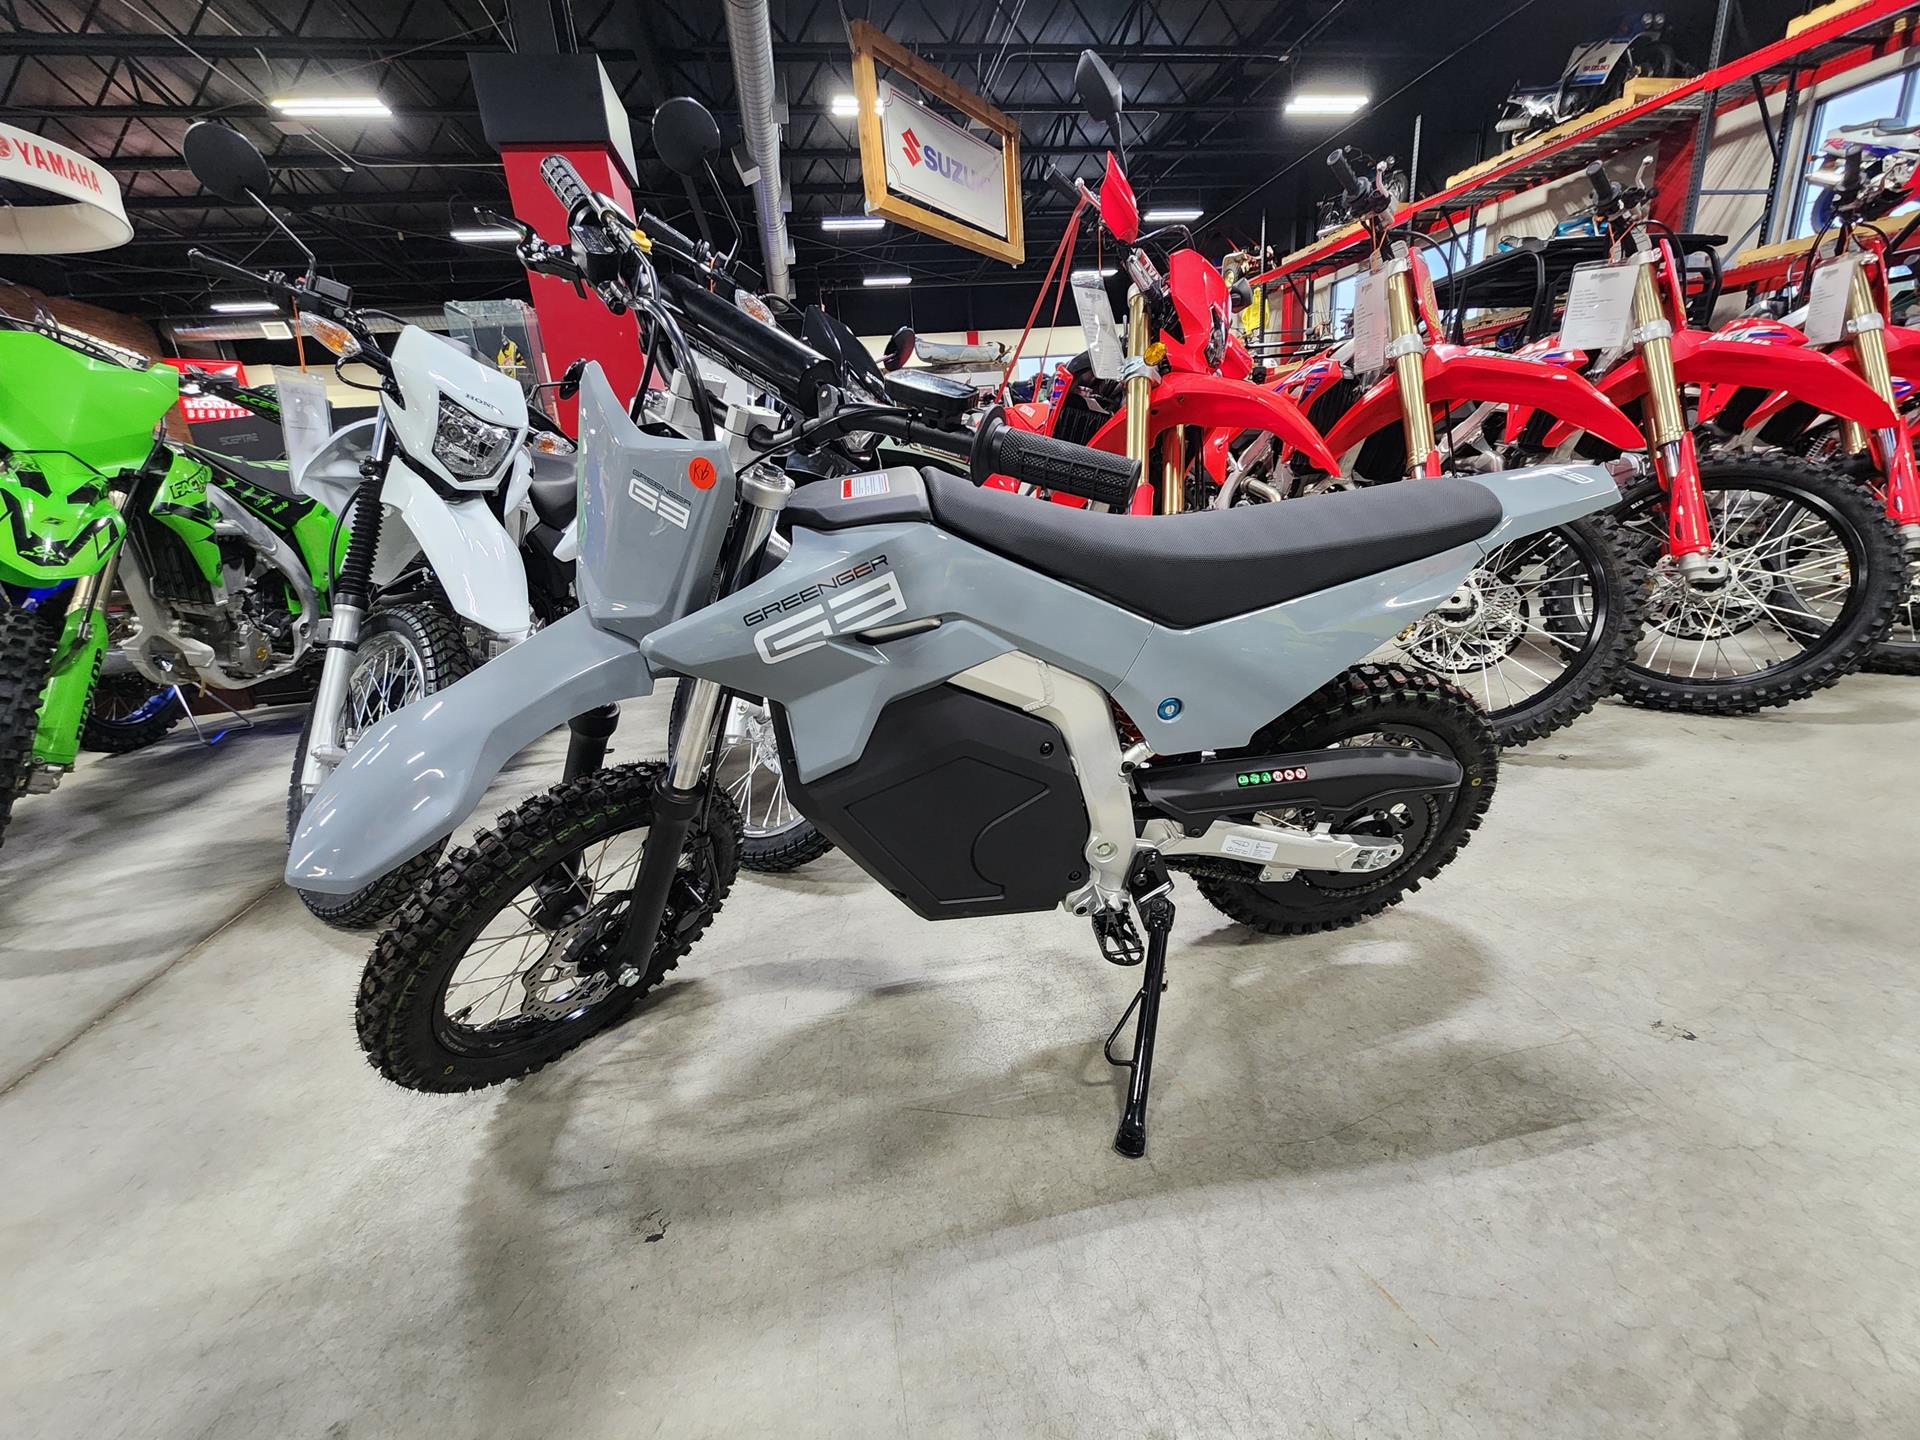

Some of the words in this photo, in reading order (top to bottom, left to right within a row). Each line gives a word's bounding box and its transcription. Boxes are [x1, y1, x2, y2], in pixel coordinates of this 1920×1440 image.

[12, 137, 103, 194] YAMAHA
[923, 144, 992, 195] SUZU
[683, 331, 782, 402] REENGER
[183, 399, 240, 410] HOND
[632, 468, 692, 507] GREENGER
[742, 554, 889, 627] GREENGER
